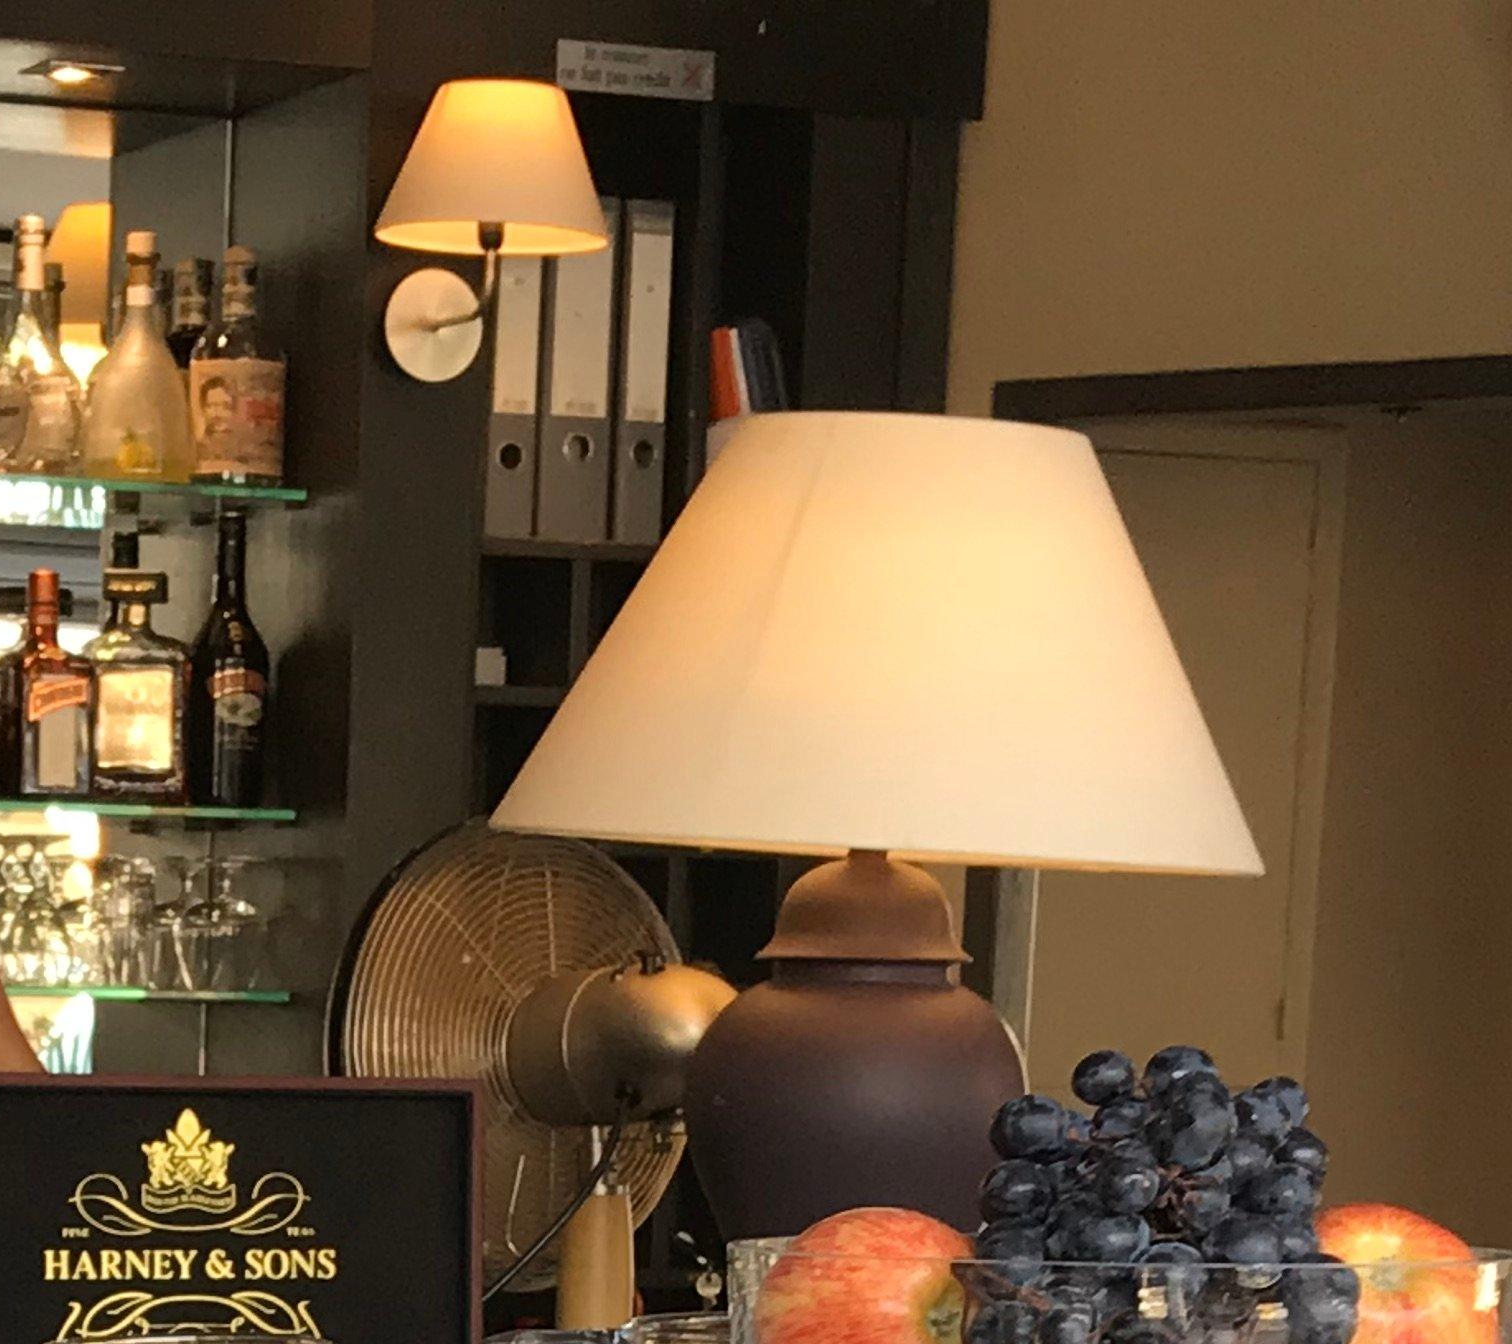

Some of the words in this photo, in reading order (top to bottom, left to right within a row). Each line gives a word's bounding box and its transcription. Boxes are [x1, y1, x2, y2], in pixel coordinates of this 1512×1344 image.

[43, 1249, 198, 1280] HARNEY
[205, 1248, 235, 1279] &
[244, 1248, 337, 1280] SONS
